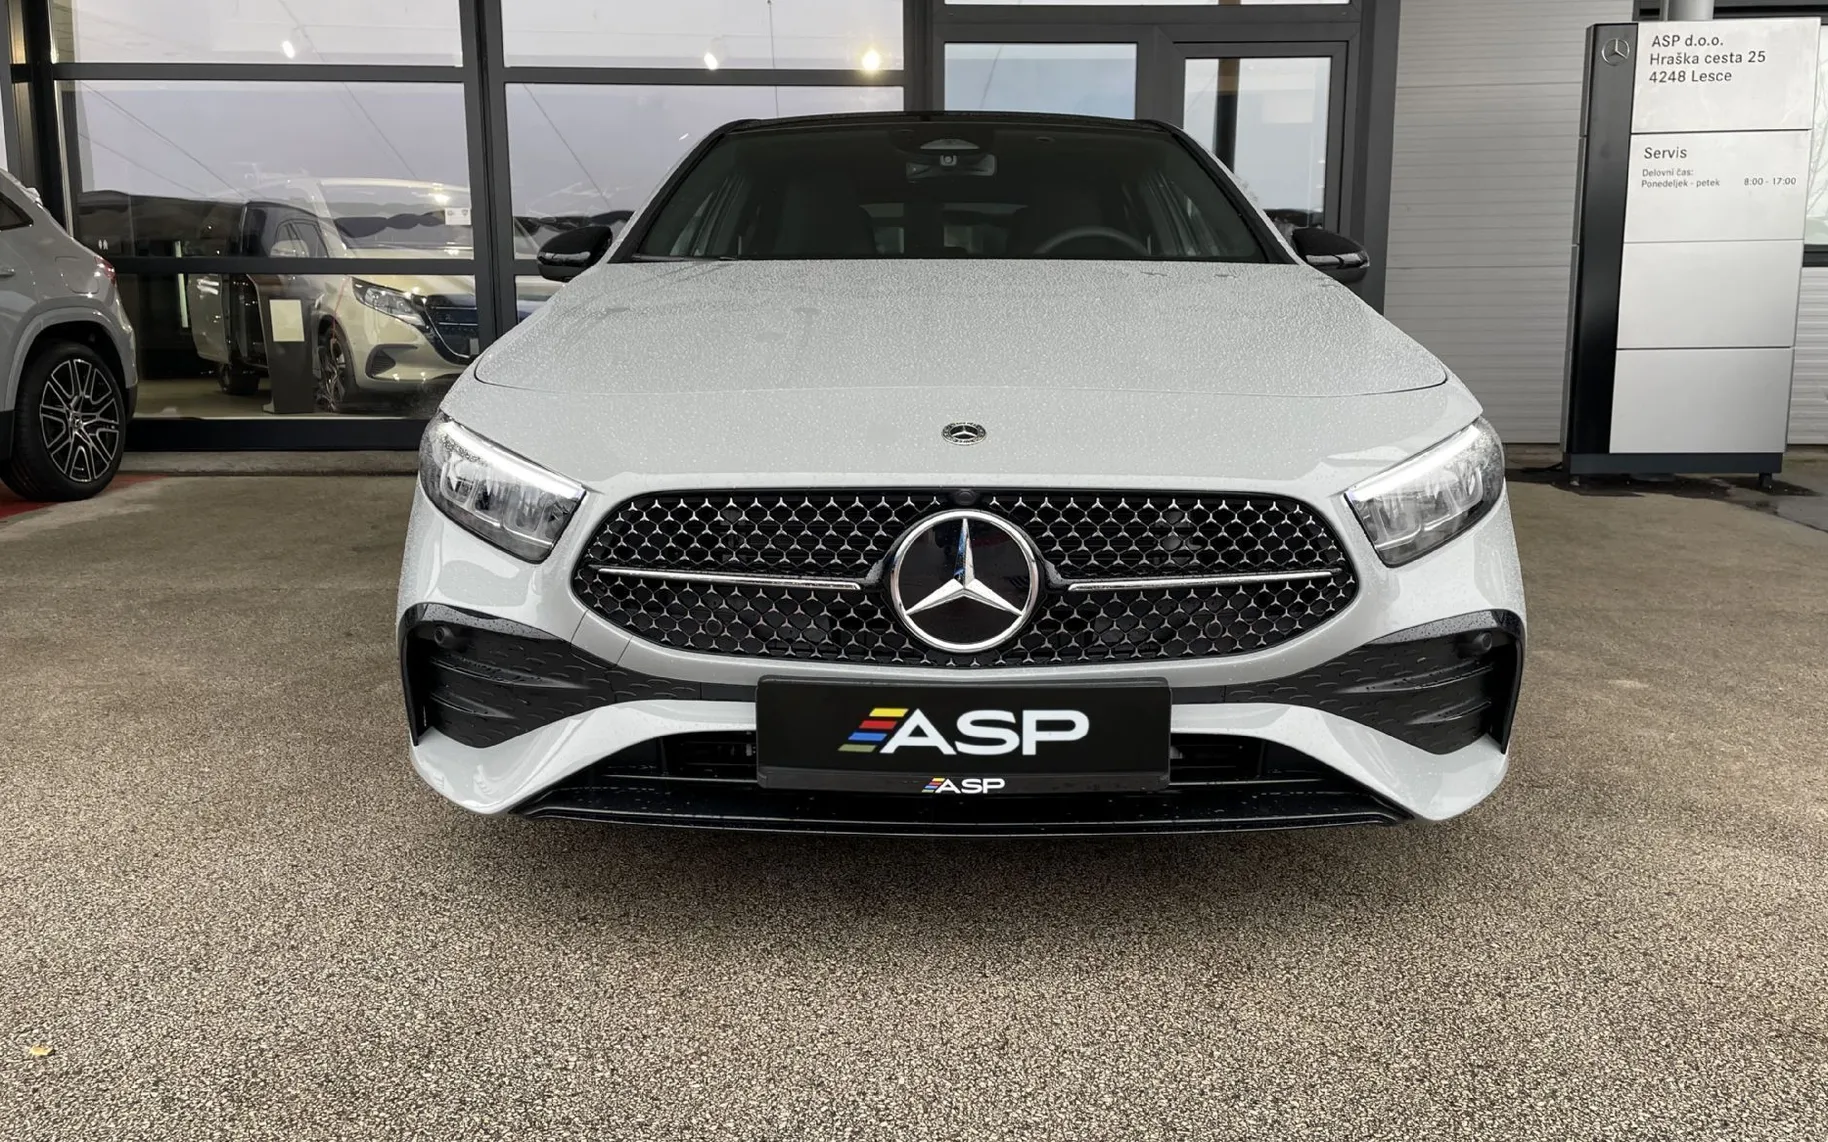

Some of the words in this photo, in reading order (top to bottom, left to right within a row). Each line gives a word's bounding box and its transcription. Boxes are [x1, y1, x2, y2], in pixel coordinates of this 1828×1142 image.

[1651, 34, 1681, 47] ASP
[1684, 34, 1724, 47] d.o.o.
[1649, 52, 1700, 66] Hraška
[1704, 52, 1743, 64] cesta
[1747, 50, 1766, 63] 25
[1649, 70, 1686, 83] 4248
[1691, 70, 1732, 82] Lesce
[1643, 146, 1688, 159] Servis
[1642, 168, 1674, 177] Delovni
[1676, 167, 1694, 176] čas:
[1641, 179, 1688, 188] Ponedeljek
[1696, 178, 1720, 188] petek
[1743, 177, 1764, 186] 8:00
[1773, 177, 1797, 185] 17:00
[879, 708, 1090, 756] ASP
[934, 778, 1006, 794] ASP
